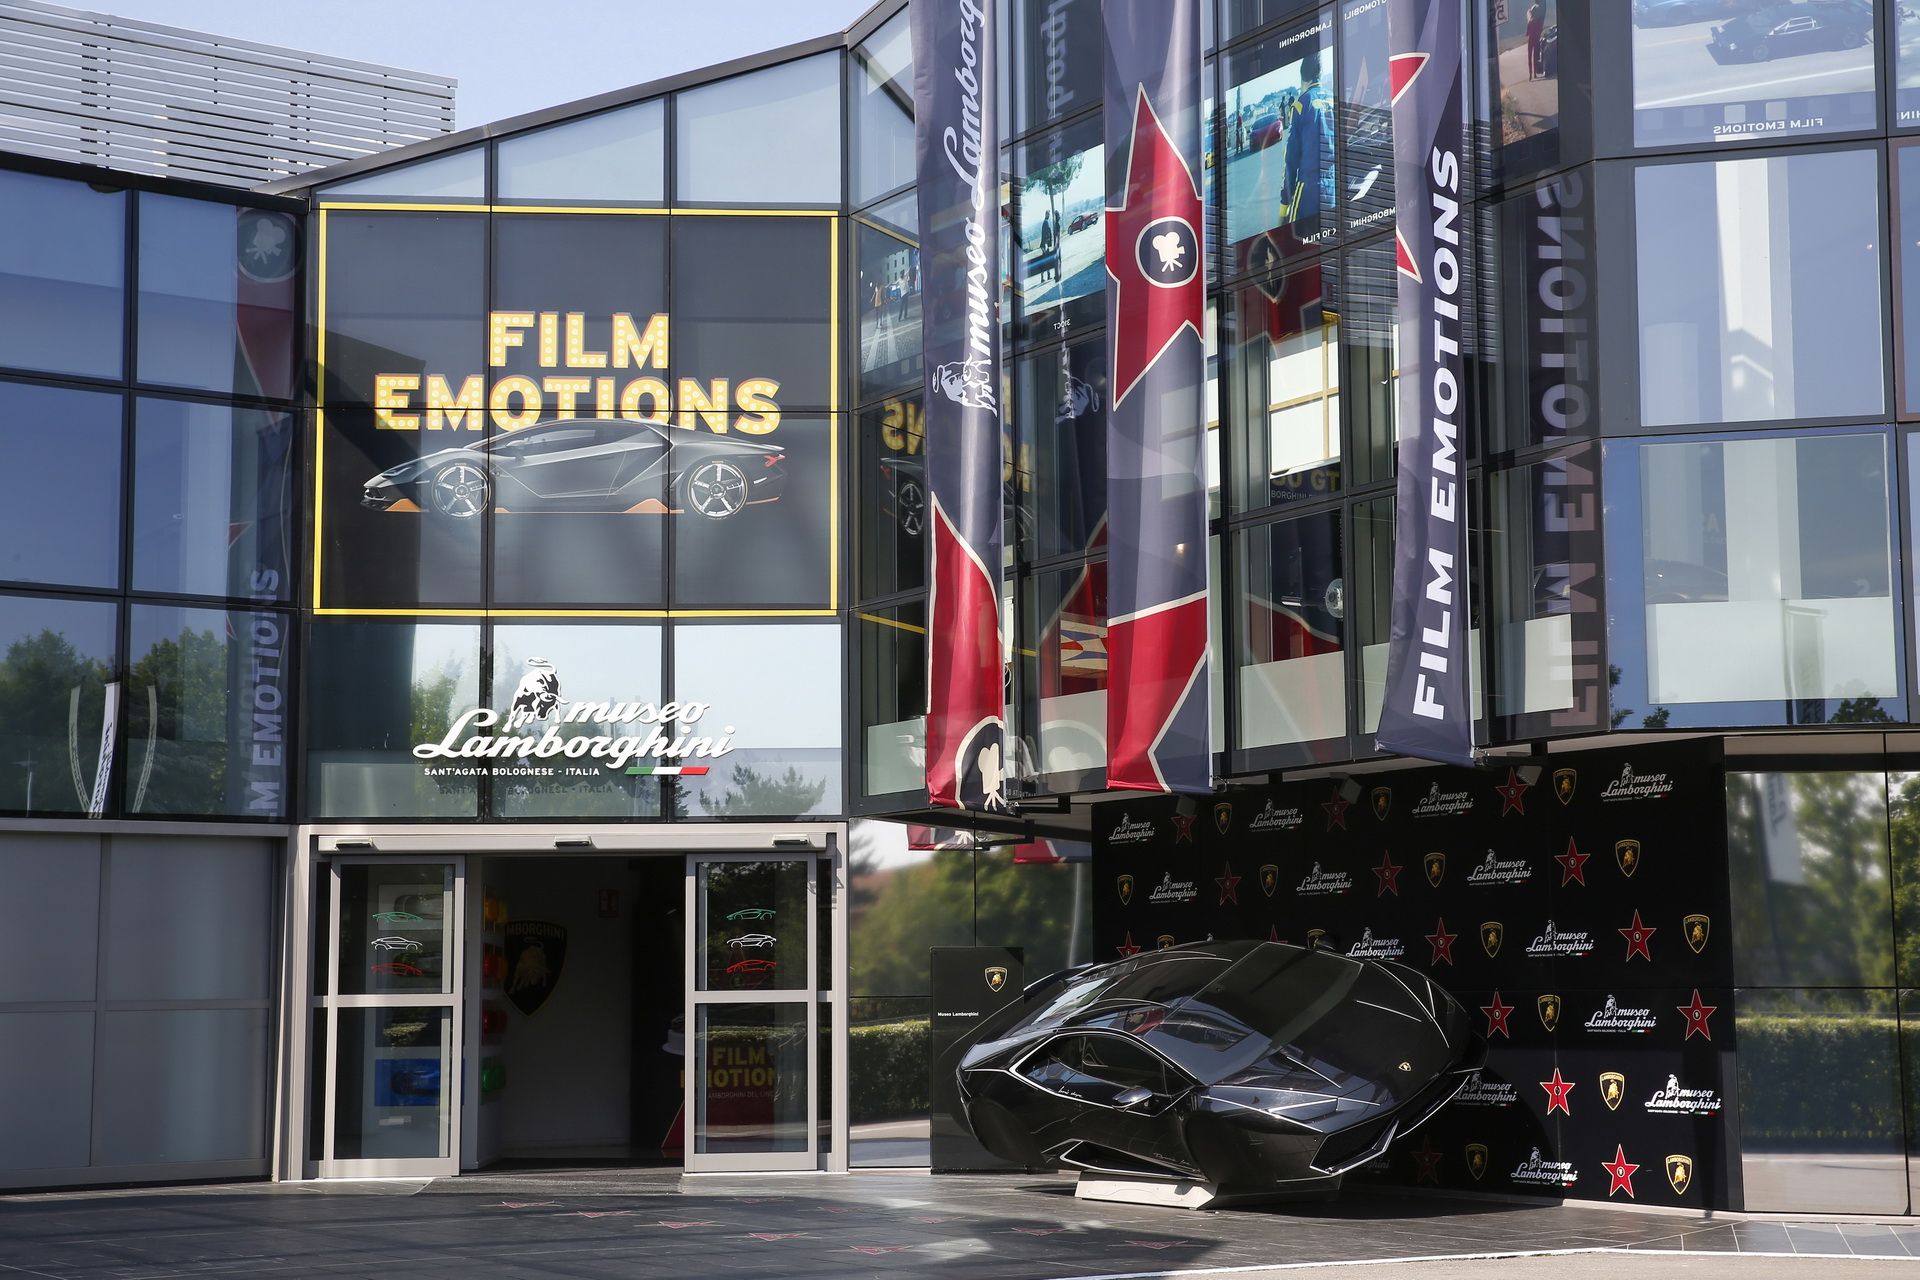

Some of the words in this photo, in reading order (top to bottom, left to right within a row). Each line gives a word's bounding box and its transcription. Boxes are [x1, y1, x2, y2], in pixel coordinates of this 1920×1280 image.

[964, 217, 991, 357] museo
[489, 310, 670, 370] FILM
[1430, 146, 1459, 523] EMOTIONS
[373, 372, 783, 436] EMOTIONS
[1412, 547, 1454, 721] FILM
[564, 700, 711, 724] museo
[412, 708, 737, 769] Lamborghini
[424, 767, 488, 776] SANT'AGATA
[492, 767, 555, 776] BOLOGNESE
[565, 767, 600, 776] ITALIA
[1633, 773, 1667, 783] museo
[1440, 790, 1469, 800] museo
[1600, 780, 1674, 798] Lamborghini
[1412, 798, 1474, 814] Lamborghini
[1249, 814, 1303, 828] Lamborghini
[1108, 827, 1155, 840] Lamborghini
[1496, 860, 1527, 869] museo
[1466, 865, 1532, 882] Lamborghini
[1149, 887, 1198, 900] Lamborghini
[1556, 932, 1589, 940] museo
[1345, 942, 1405, 959] Lamborghini
[1584, 1011, 1657, 1030] Lamborghini
[1616, 1008, 1651, 1016] museo
[712, 1046, 765, 1066] FILM
[1453, 1084, 1518, 1104] Lamborghini
[1482, 1083, 1512, 1091] museo
[1679, 1089, 1715, 1098] museo
[1644, 1091, 1722, 1112] Lamborghini
[1510, 1162, 1578, 1183] Lamborghini
[1541, 1161, 1573, 1170] museo
